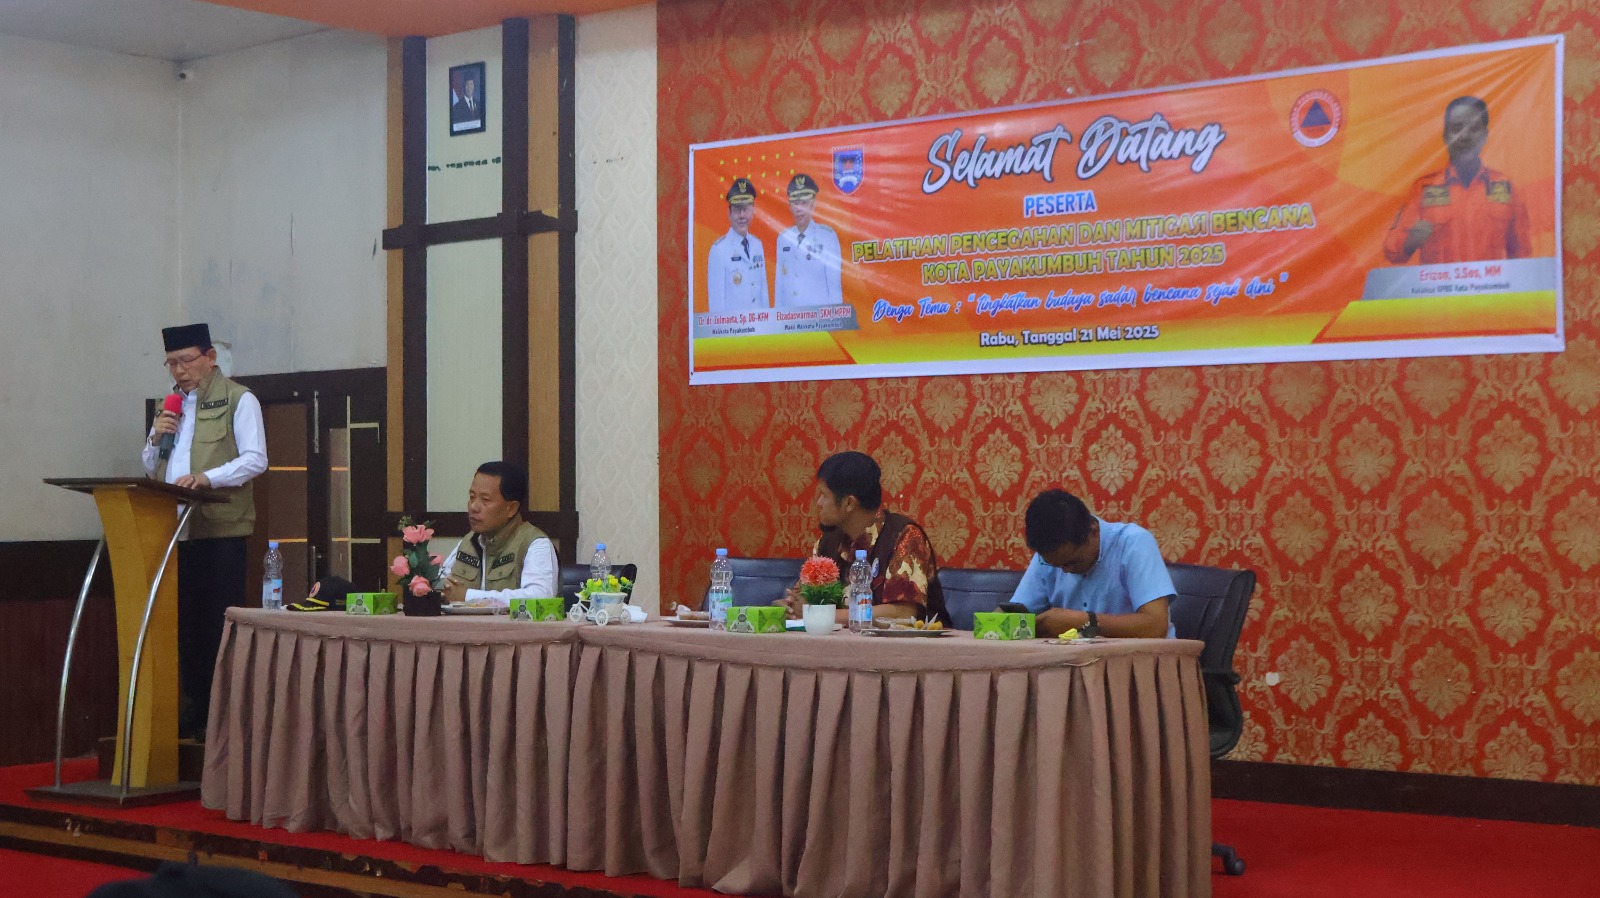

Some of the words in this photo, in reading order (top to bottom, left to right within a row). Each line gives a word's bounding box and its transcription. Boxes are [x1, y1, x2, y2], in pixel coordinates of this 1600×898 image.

[922, 123, 1073, 194] Selamat
[1076, 112, 1227, 180] Datang
[1024, 190, 1097, 217] PESERTA
[852, 235, 947, 264] PELATIHAN
[949, 223, 1076, 255] PENCEGAHAN
[1078, 218, 1121, 245] DAN
[1124, 212, 1209, 242] MITIGASI
[1210, 203, 1316, 235] BENCANA
[922, 261, 971, 285] KOTA
[973, 250, 1103, 282] PAYAKUMBUH
[1106, 244, 1176, 272] TAHUN
[1178, 242, 1226, 268] 2025
[872, 298, 914, 321] Denga
[918, 295, 950, 317] Tema
[1044, 289, 1094, 312] budaya
[1097, 285, 1137, 308] sadar
[1143, 283, 1202, 304] bencana
[1204, 277, 1242, 306] sejak
[980, 332, 1019, 347] Rabu,
[1022, 327, 1077, 346] Tanggal
[1079, 328, 1093, 342] 21
[1096, 326, 1122, 341] Mei
[1124, 325, 1160, 340] 2025
